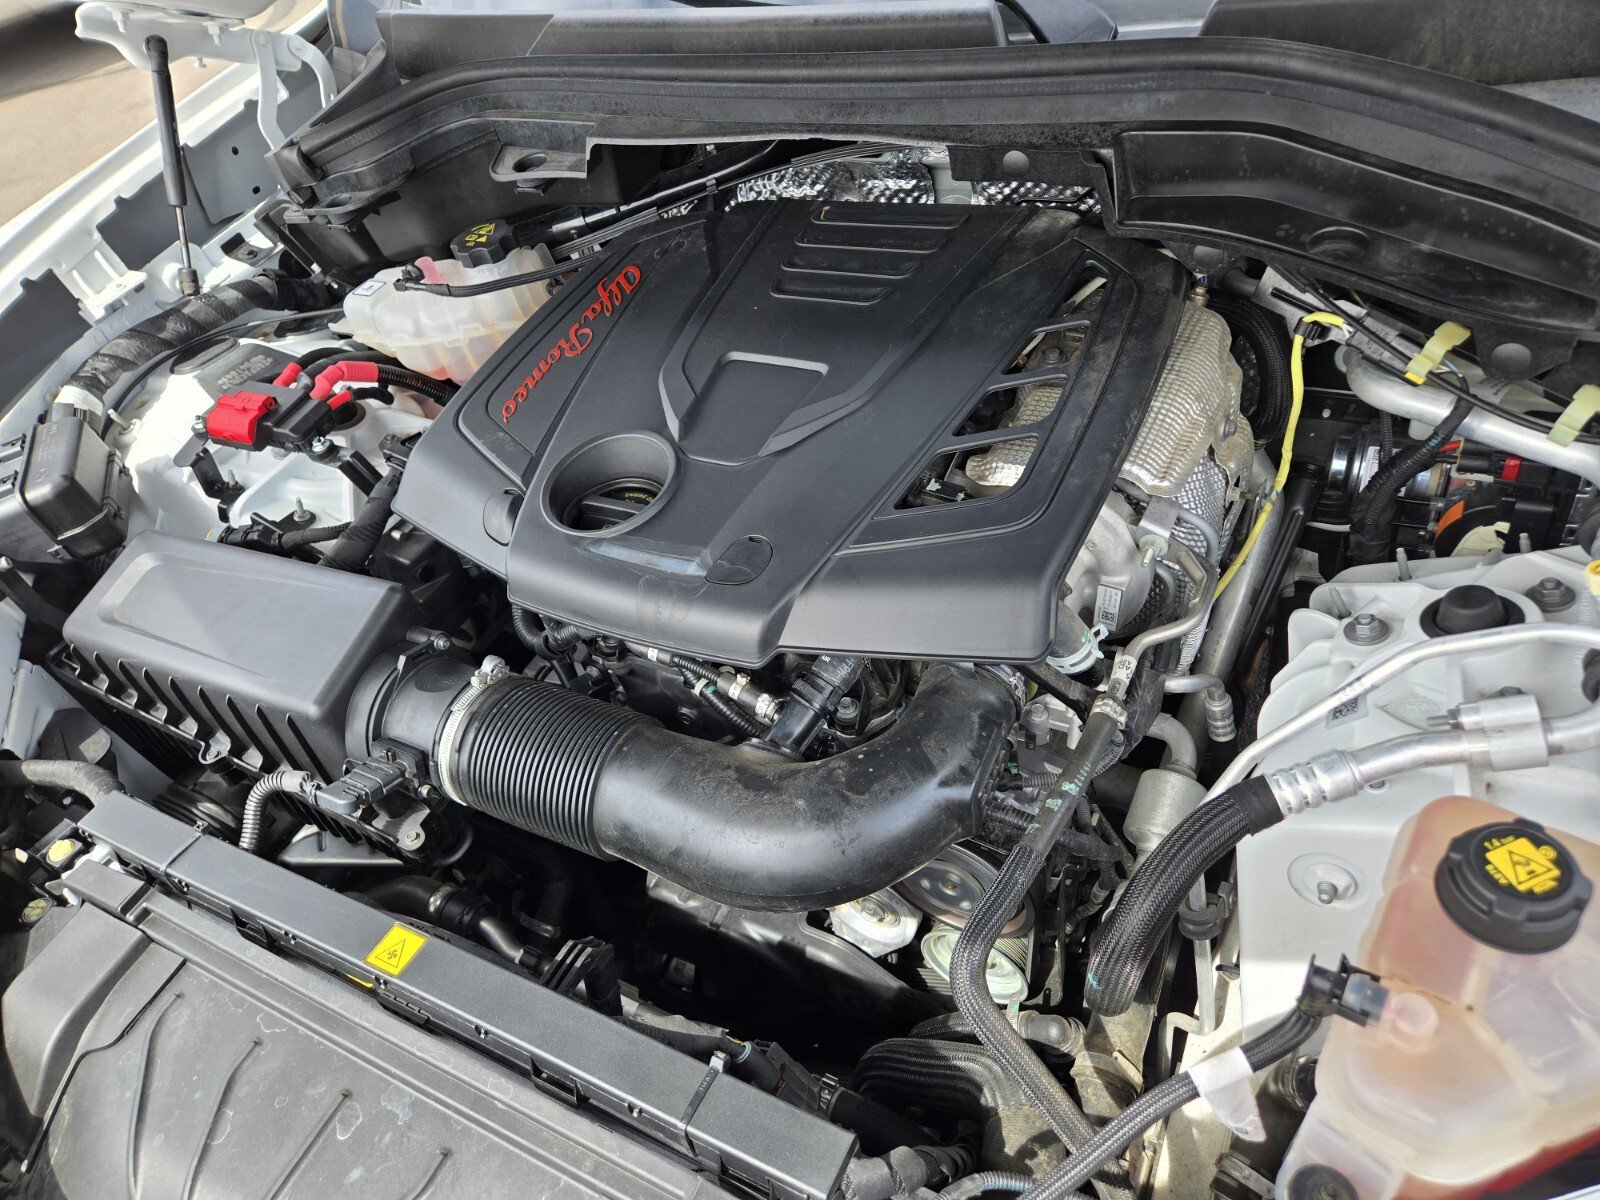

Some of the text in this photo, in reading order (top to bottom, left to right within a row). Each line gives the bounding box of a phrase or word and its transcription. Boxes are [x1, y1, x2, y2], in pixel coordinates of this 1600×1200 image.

[502, 265, 641, 423] Alfa Romeo
[624, 492, 646, 500] ENGINE
